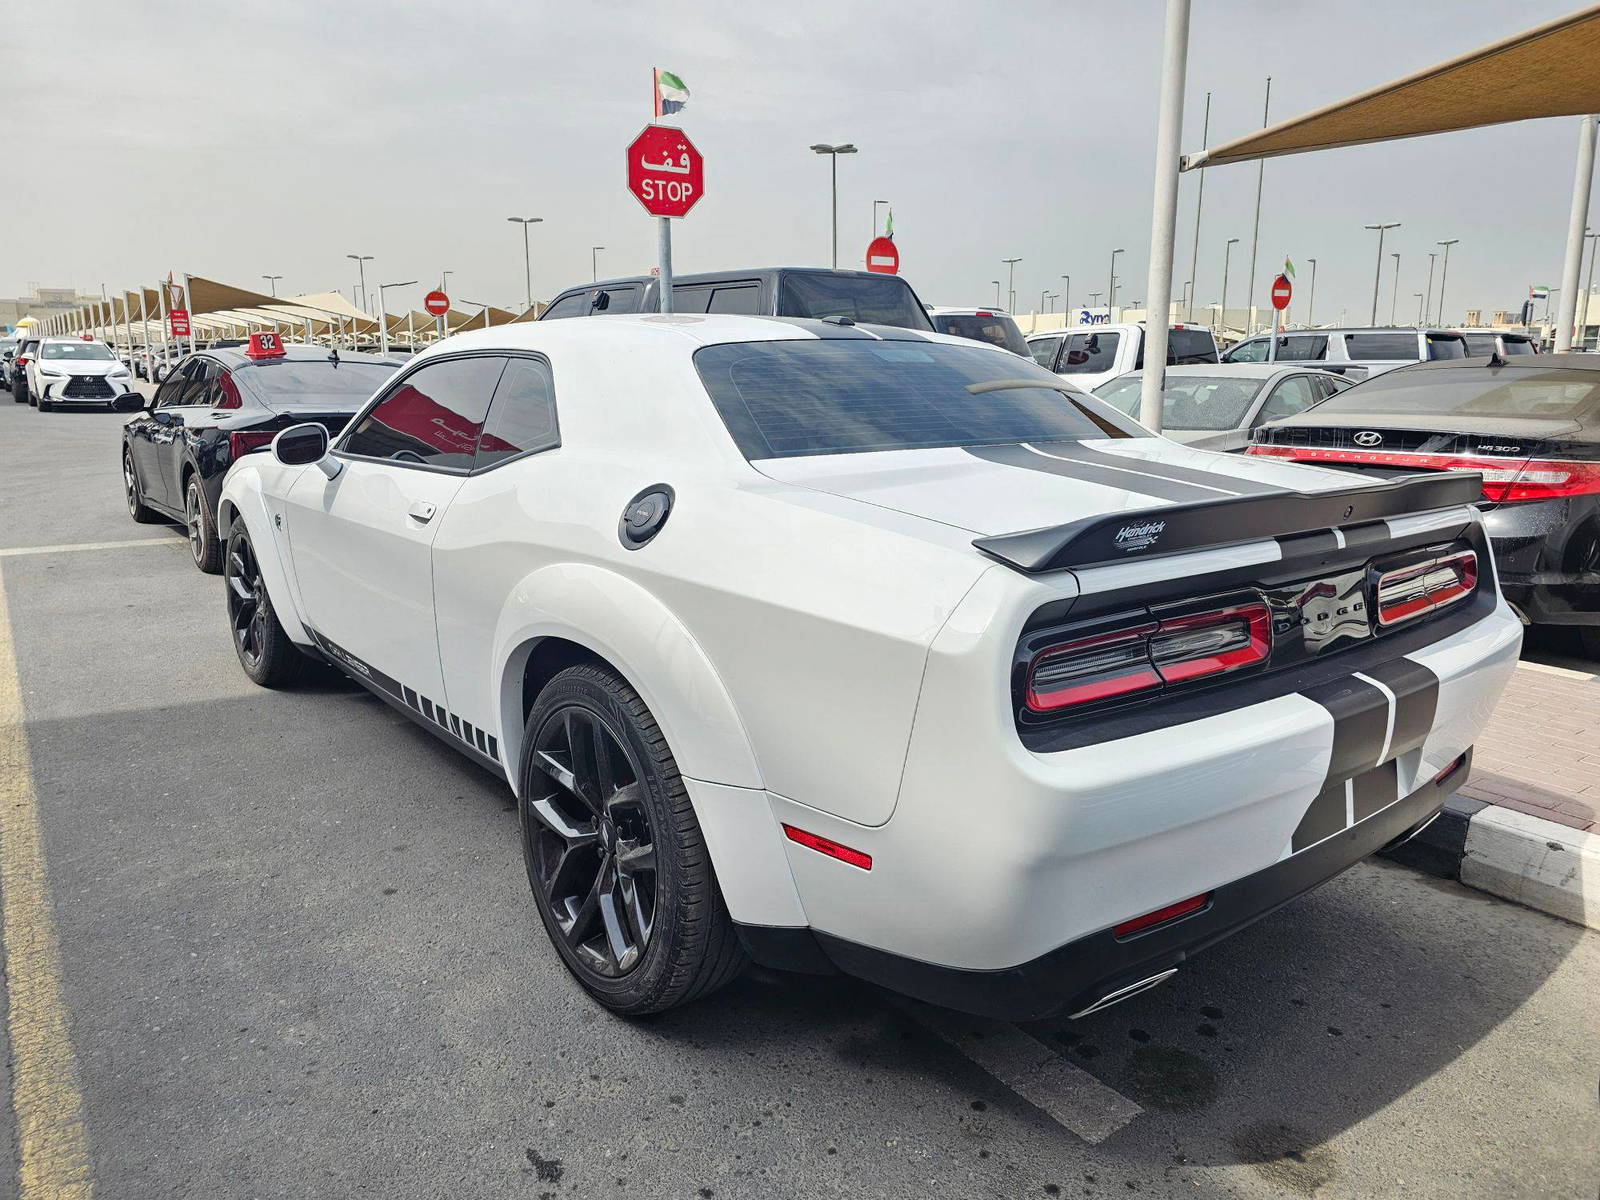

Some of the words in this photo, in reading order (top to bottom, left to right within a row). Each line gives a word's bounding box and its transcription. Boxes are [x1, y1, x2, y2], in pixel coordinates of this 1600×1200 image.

[641, 144, 690, 175] قف
[641, 178, 693, 202] STOP
[260, 334, 276, 350] 32
[1310, 451, 1429, 463] GRANDEUR
[1276, 602, 1364, 634] DODGE
